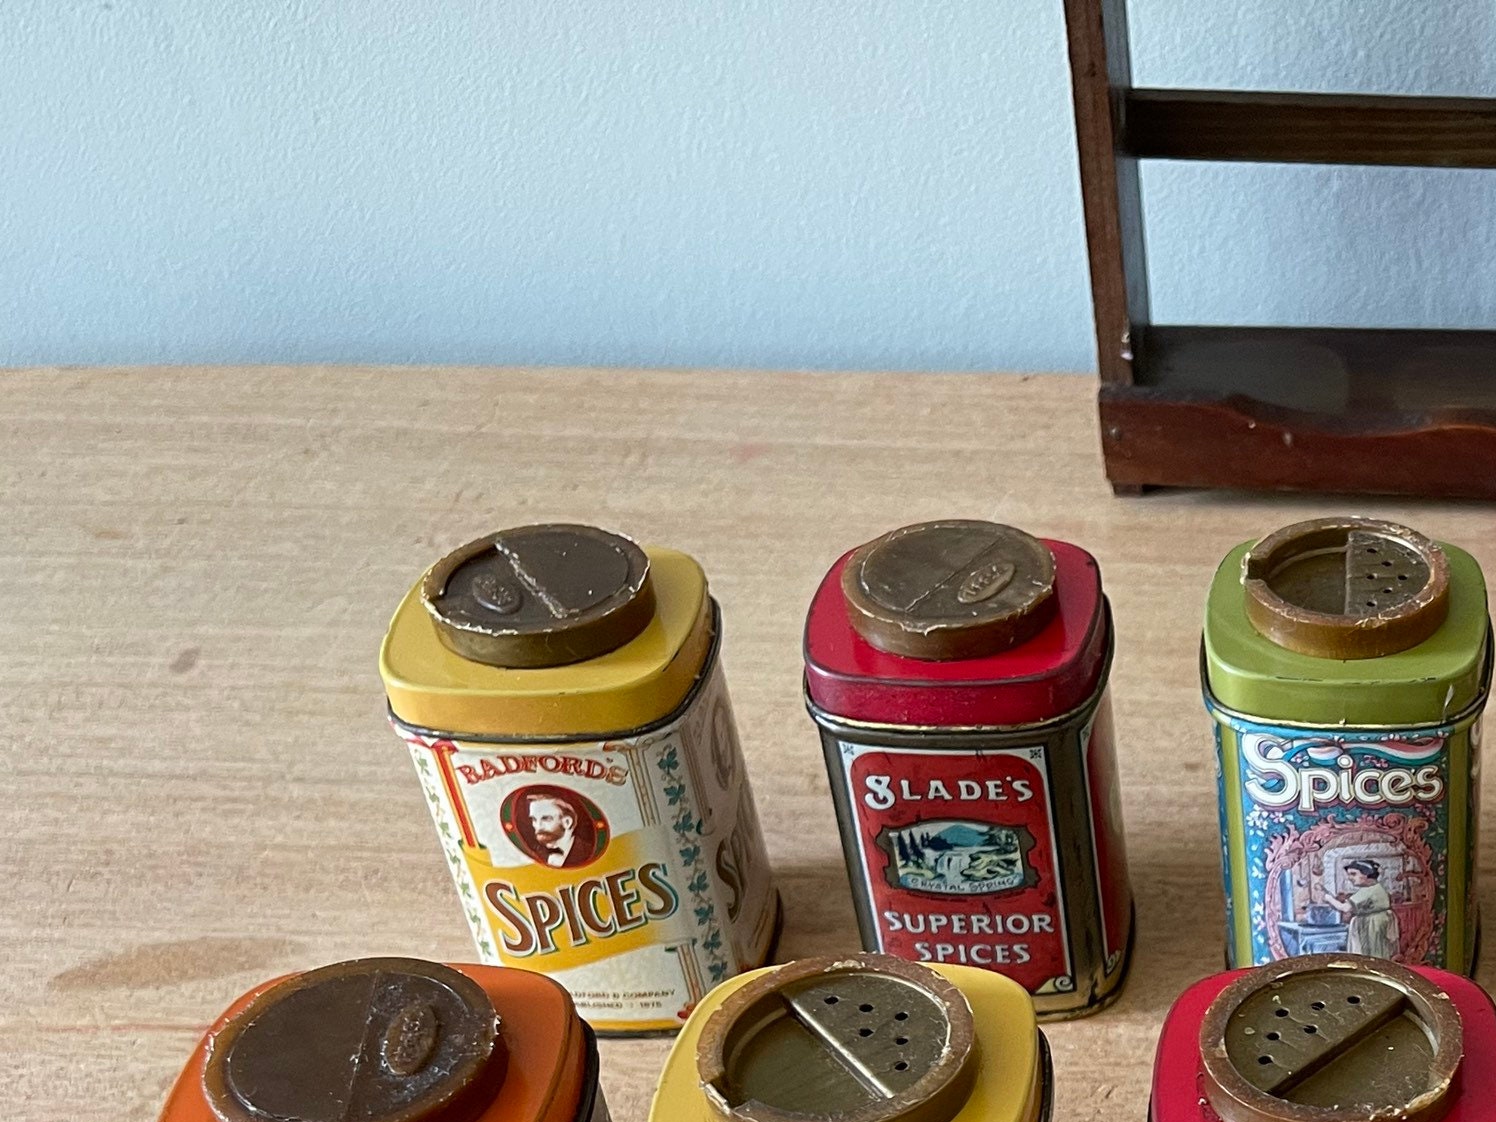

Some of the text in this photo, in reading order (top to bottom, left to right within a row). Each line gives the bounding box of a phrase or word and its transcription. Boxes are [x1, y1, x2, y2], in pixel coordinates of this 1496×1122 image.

[1241, 732, 1444, 811] Spices
[865, 775, 1033, 810] SLADE'S
[485, 861, 680, 959] SPICES
[884, 911, 1054, 934] SUPERIOR
[915, 942, 1031, 964] SPICES
